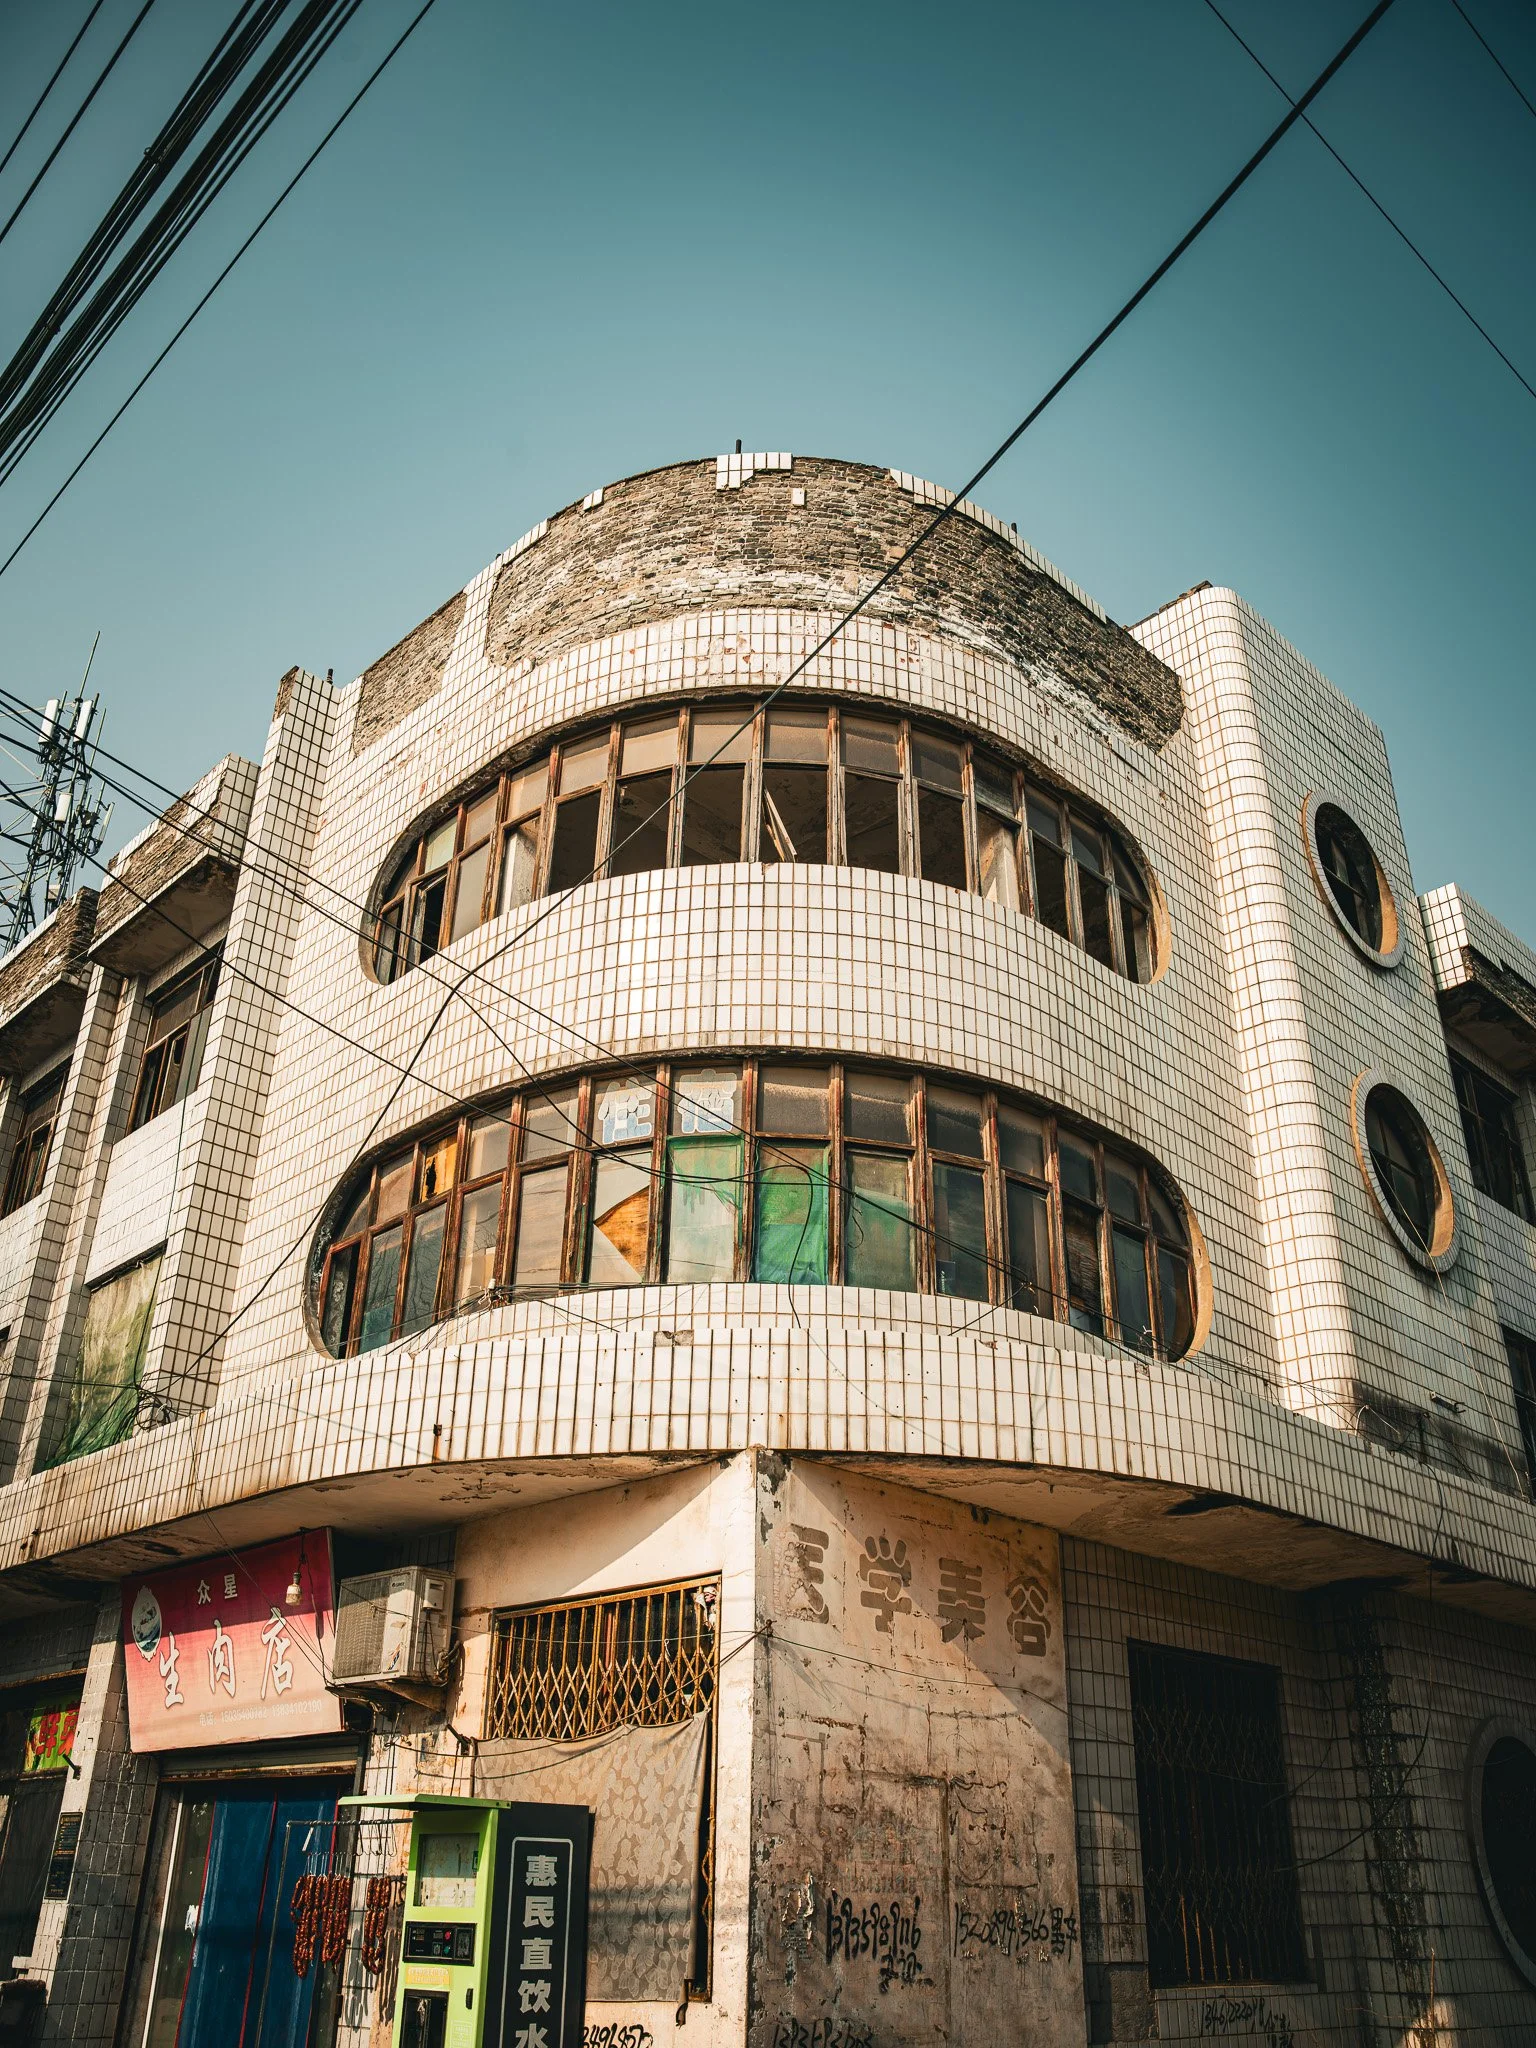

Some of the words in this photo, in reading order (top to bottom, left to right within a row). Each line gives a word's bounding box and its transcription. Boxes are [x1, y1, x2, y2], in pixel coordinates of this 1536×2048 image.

[598, 1068, 737, 1145] 住宿
[197, 1573, 239, 1605] 众星
[158, 1607, 295, 1709] 生肉店
[515, 1854, 559, 2048] 惠民直饮水
